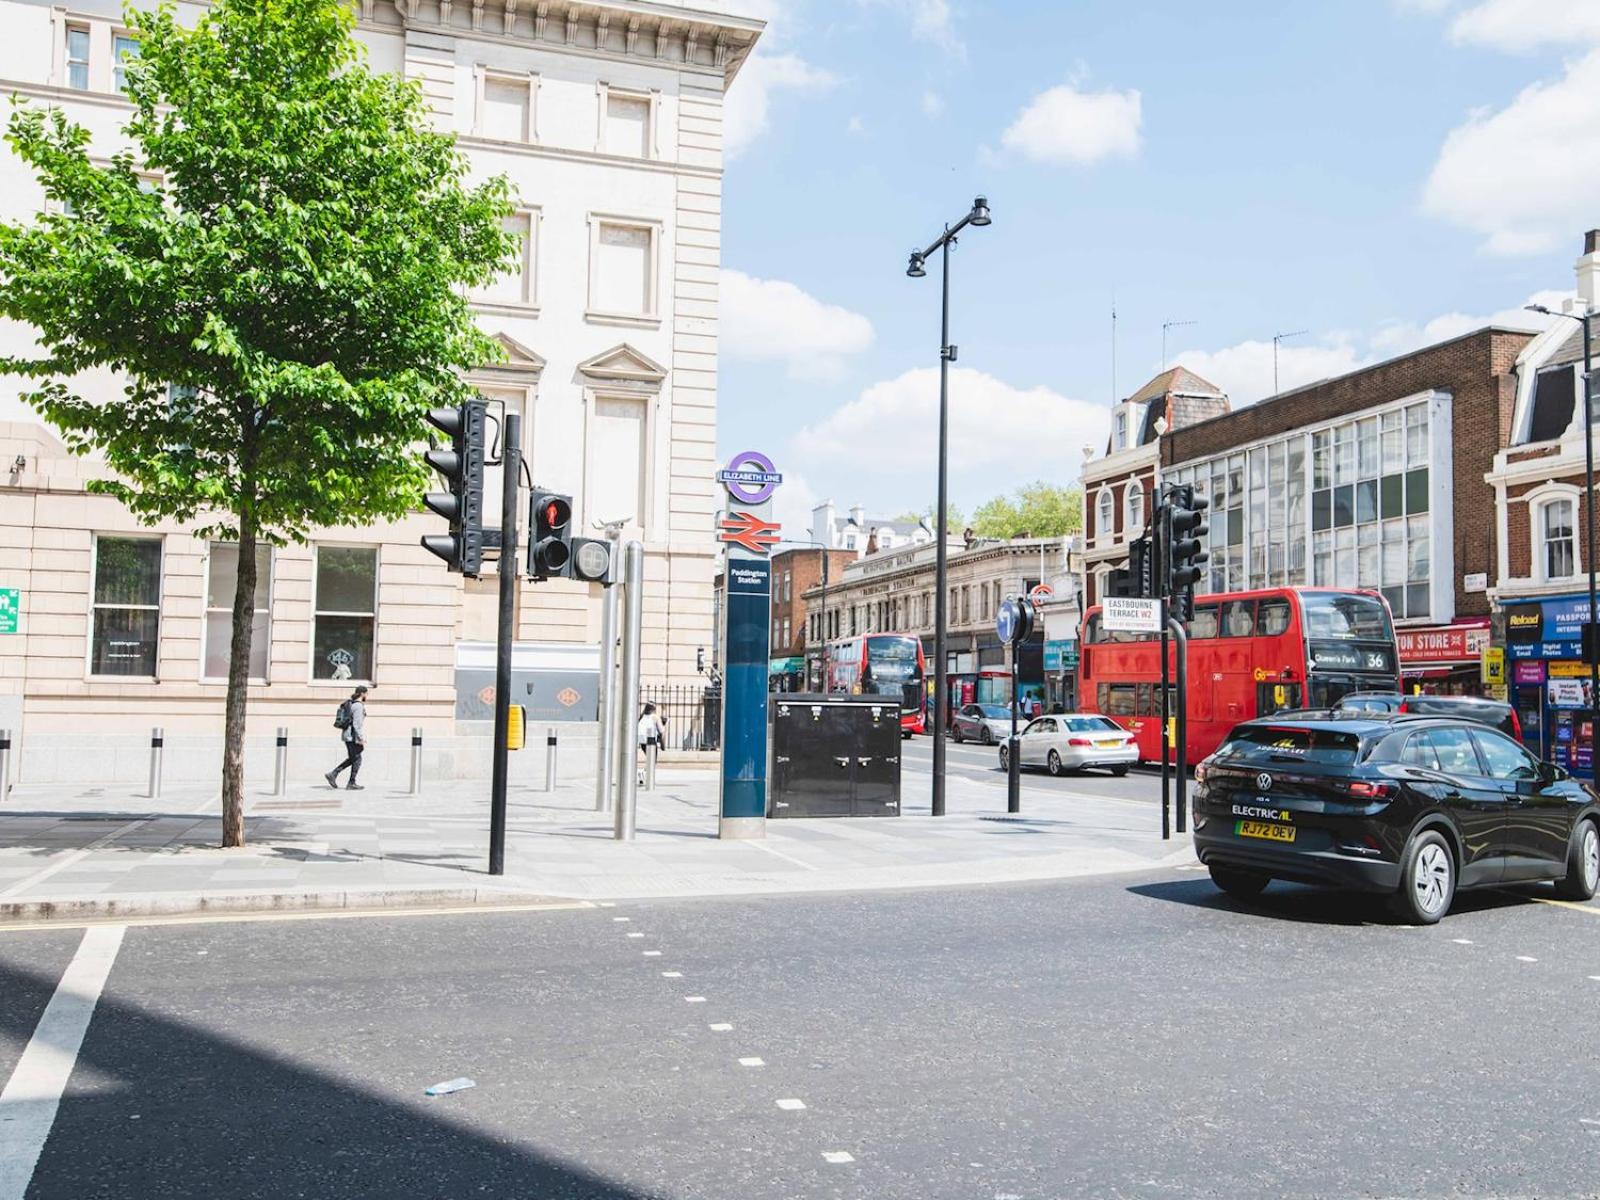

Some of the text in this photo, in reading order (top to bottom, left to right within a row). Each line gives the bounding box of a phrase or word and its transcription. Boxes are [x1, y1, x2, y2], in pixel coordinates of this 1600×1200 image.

[724, 472, 780, 482] ELIZABETH LINE
[731, 569, 767, 579] Paddington
[1109, 600, 1153, 609] EASTBOURNE
[1110, 609, 1152, 619] TERRACE W2
[1556, 613, 1591, 622] PASSPOR
[1510, 614, 1539, 625] Reload
[1417, 633, 1449, 650] STORE
[1368, 654, 1384, 667] 36
[1242, 821, 1270, 836] RJ72
